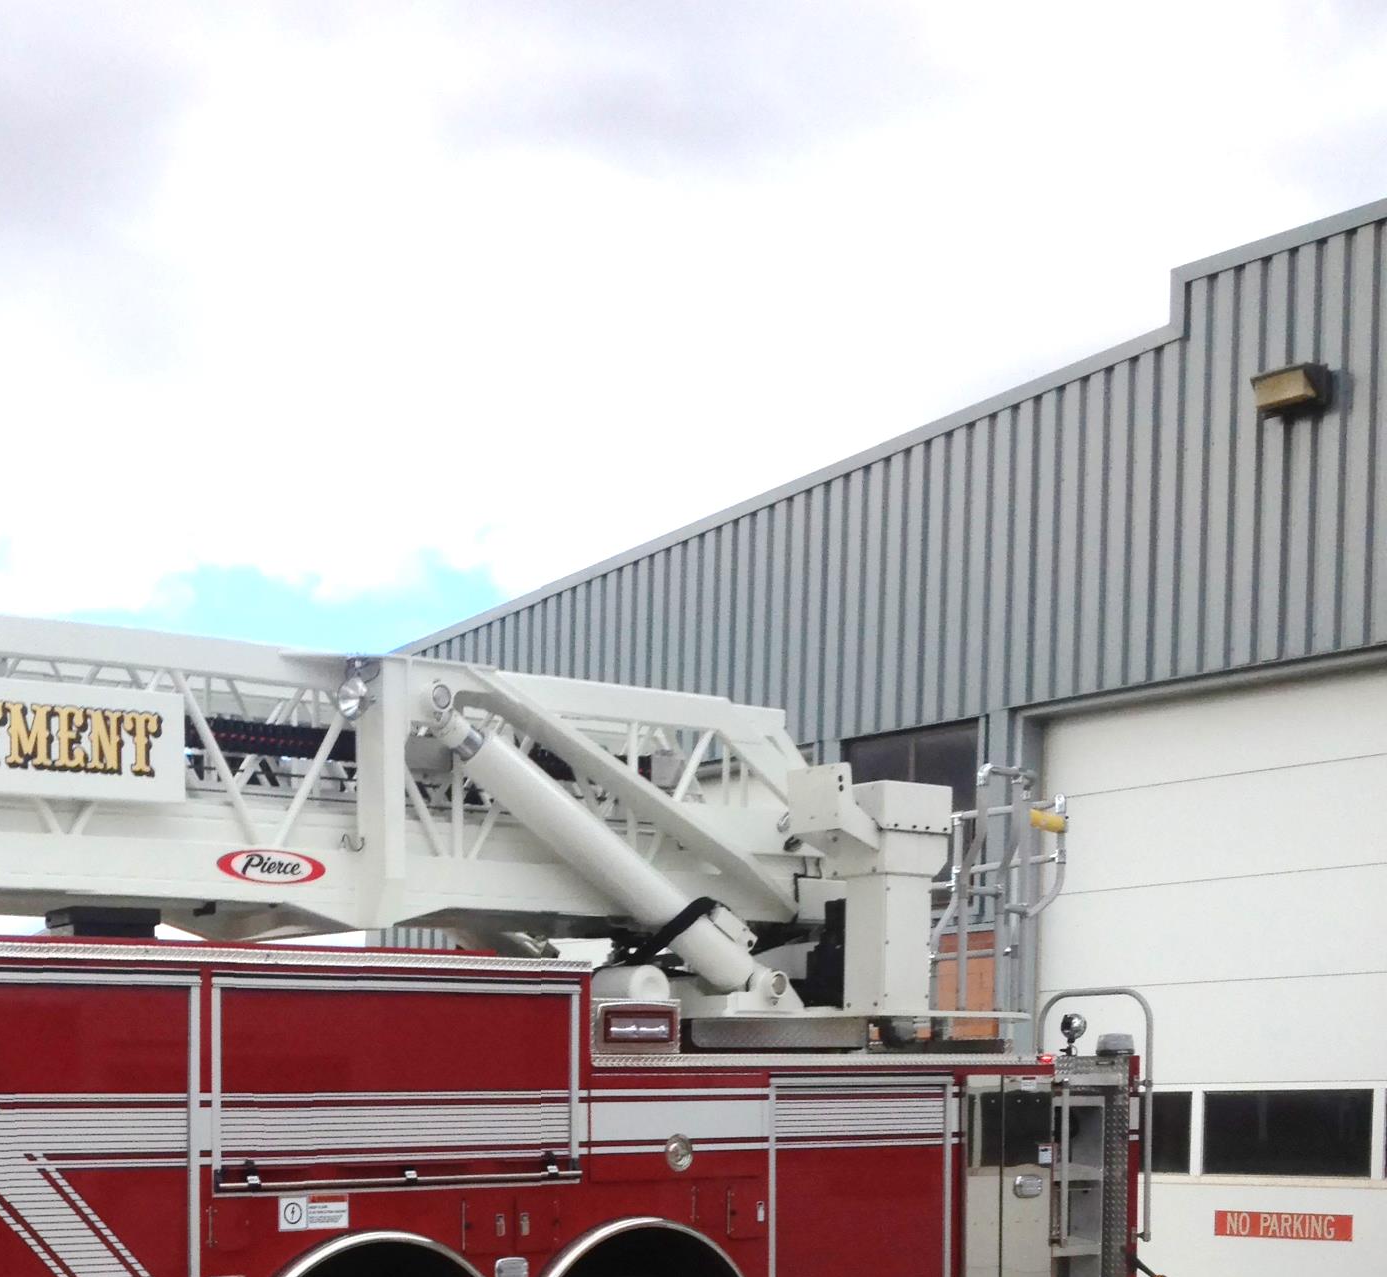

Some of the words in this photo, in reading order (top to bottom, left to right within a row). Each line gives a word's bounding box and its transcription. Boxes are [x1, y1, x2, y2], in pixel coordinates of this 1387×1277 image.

[241, 853, 302, 876] Pierce
[1226, 1212, 1250, 1236] NO
[1260, 1213, 1335, 1240] PARKING
